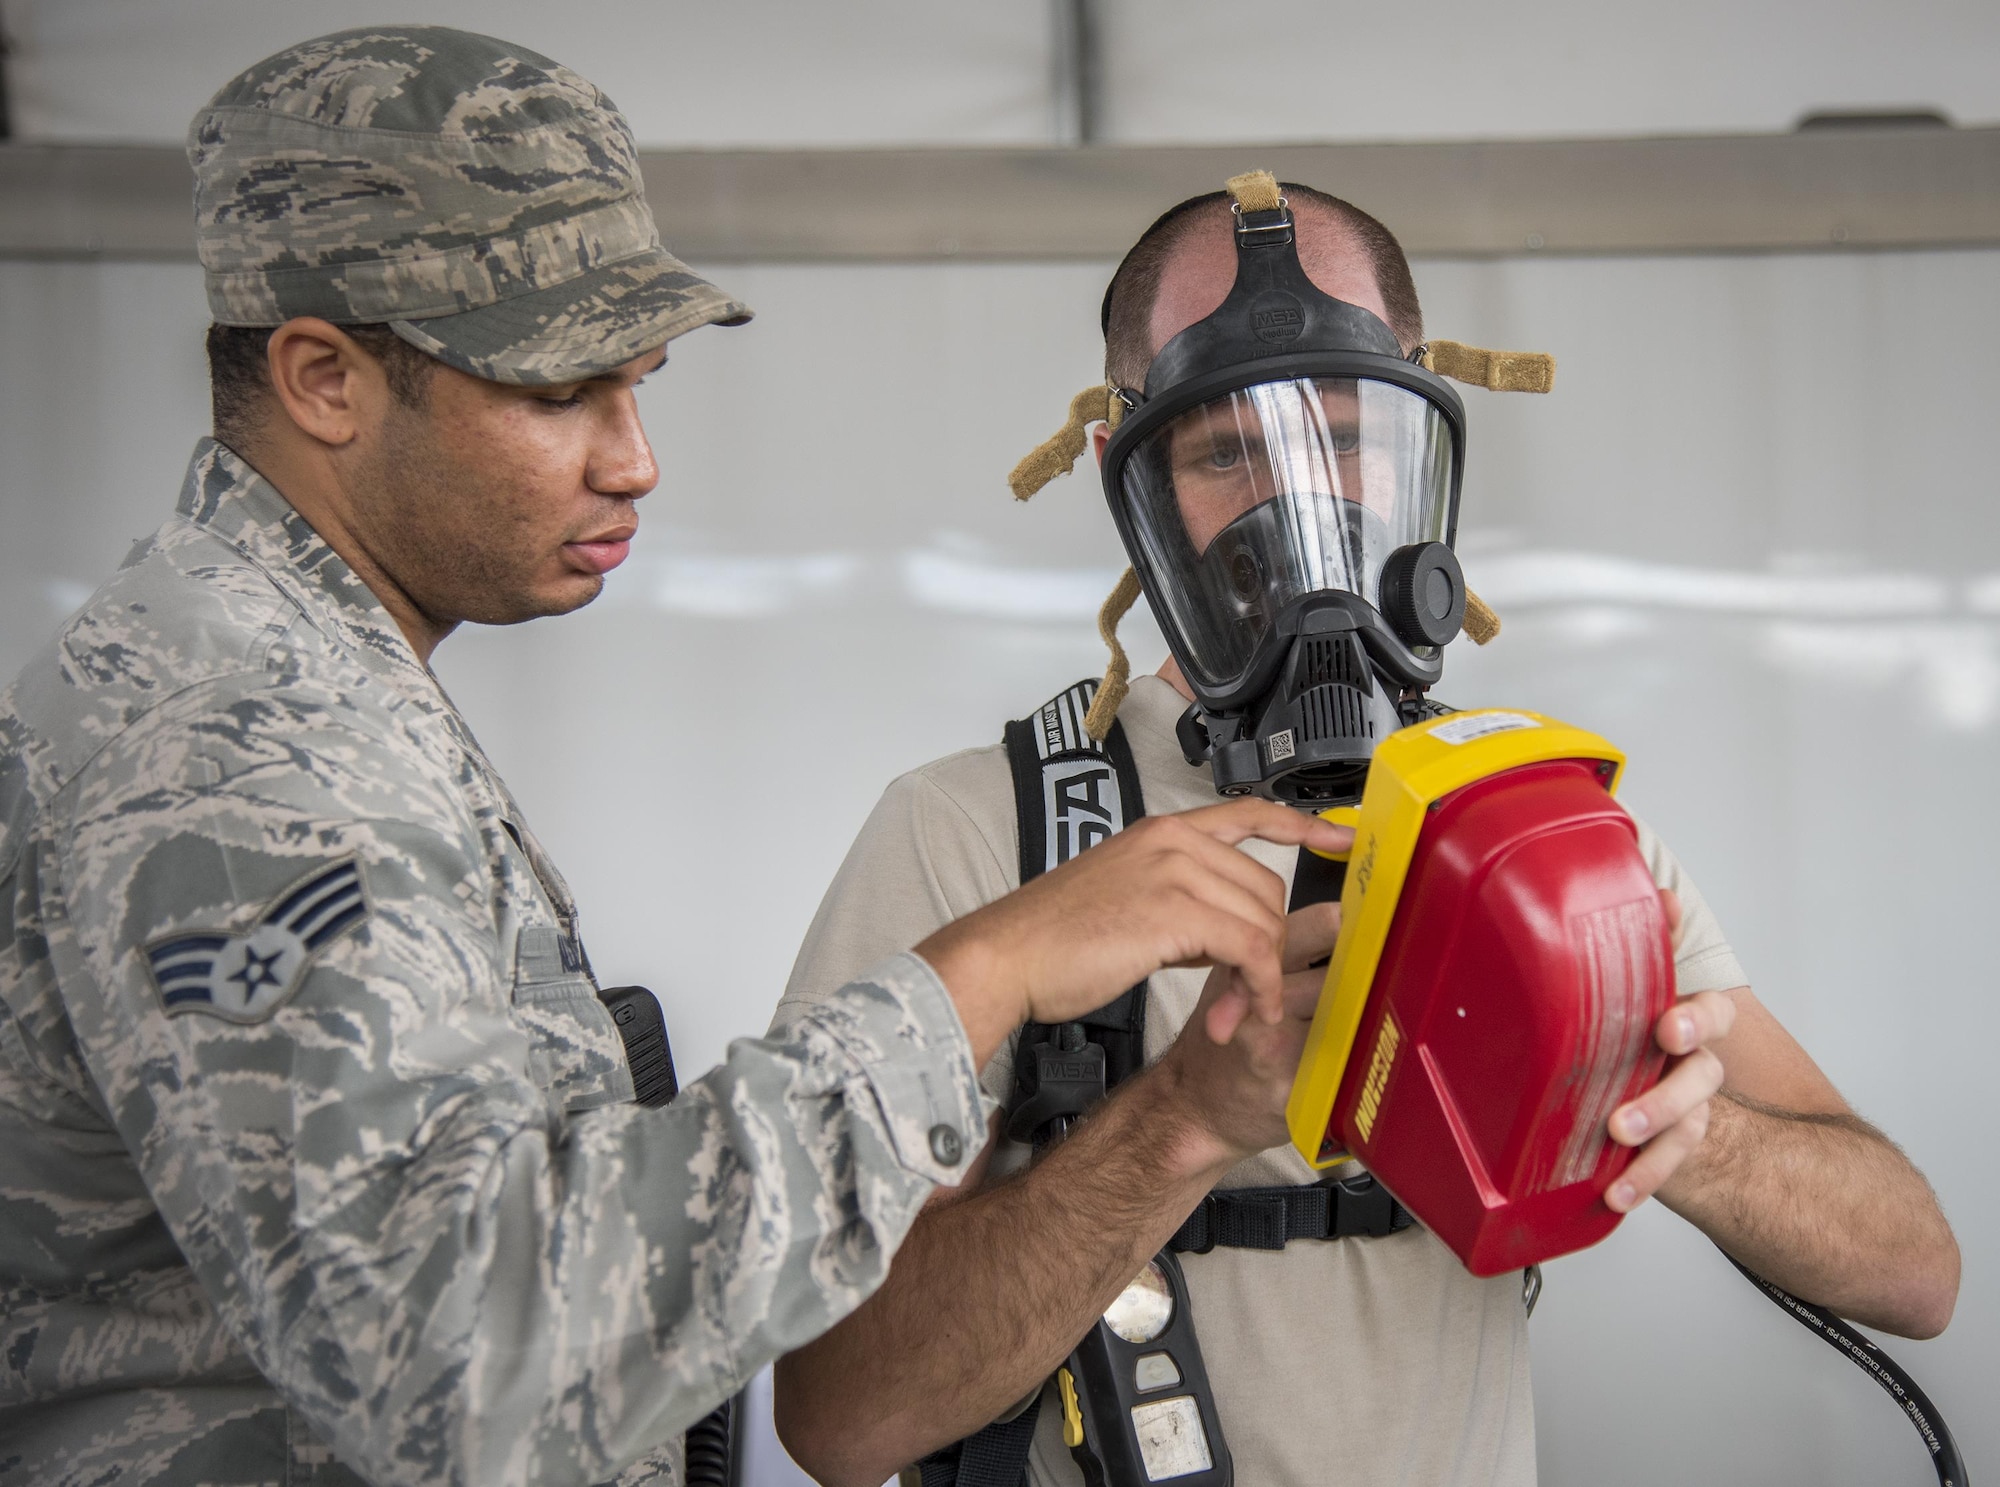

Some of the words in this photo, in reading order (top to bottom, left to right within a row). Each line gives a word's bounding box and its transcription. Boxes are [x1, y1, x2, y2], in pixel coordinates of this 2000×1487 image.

[1255, 308, 1302, 328] MSA
[1049, 728, 1061, 745] AIR
[1045, 1063, 1098, 1079] MSA
[1768, 1285, 1785, 1300] MAY
[1783, 1295, 1798, 1309] PSI
[1795, 1304, 1824, 1328] HIGHER
[1826, 1326, 1841, 1340] PSI
[1839, 1336, 1854, 1349] 250
[1851, 1344, 1881, 1372] EXCEED
[1878, 1369, 1895, 1385] NOT
[1891, 1383, 1906, 1397] DO
[1906, 1400, 1941, 1453] WARNING
